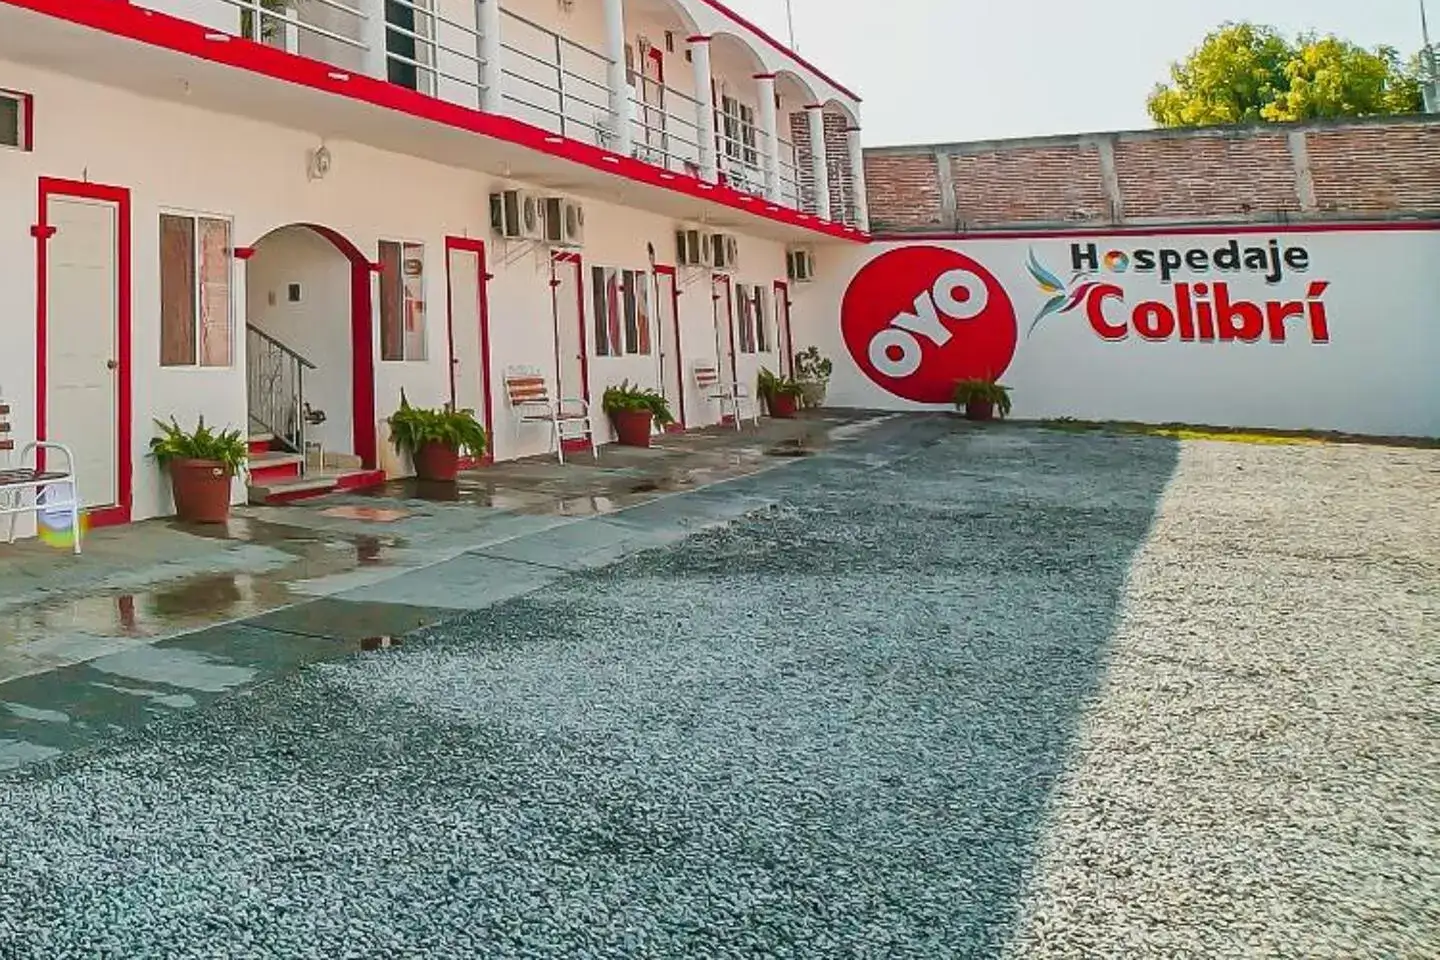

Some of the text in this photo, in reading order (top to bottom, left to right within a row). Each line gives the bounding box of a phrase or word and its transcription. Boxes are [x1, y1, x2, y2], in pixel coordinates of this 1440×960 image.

[1070, 239, 1310, 283] Hospedaje
[868, 269, 988, 377] OYO
[1086, 281, 1330, 344] Colibrí
